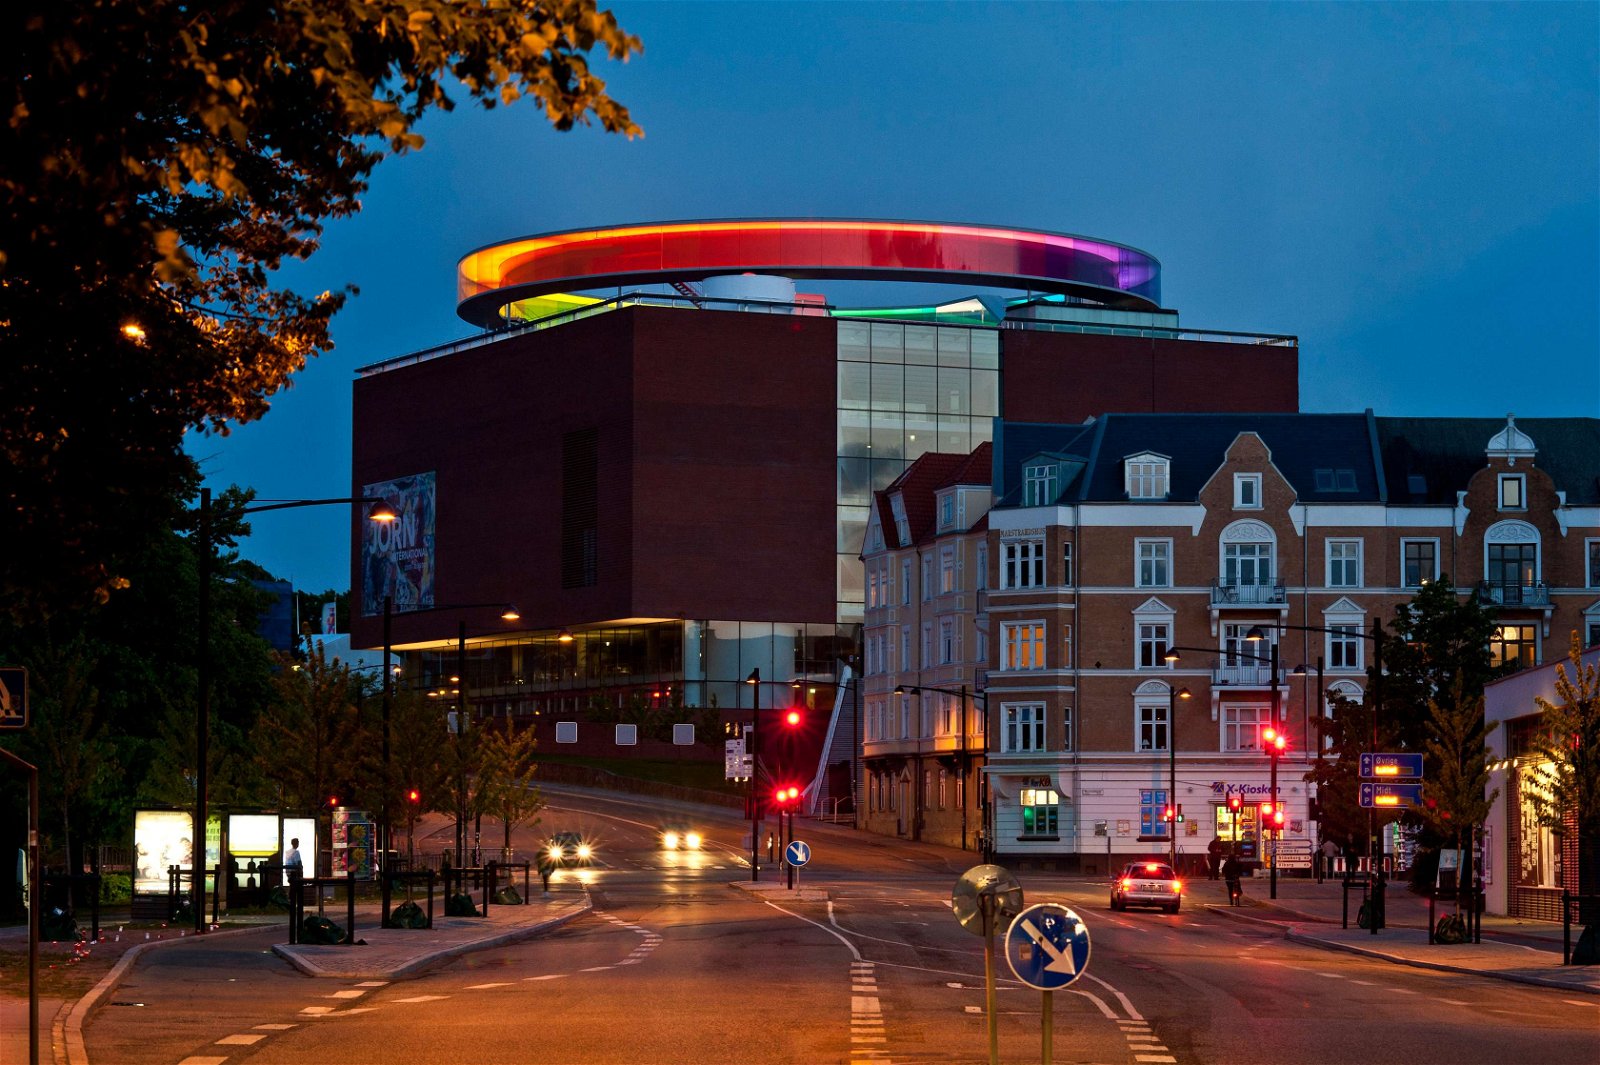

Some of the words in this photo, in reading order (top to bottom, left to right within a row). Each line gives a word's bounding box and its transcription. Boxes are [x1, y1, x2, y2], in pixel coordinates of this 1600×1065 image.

[369, 513, 416, 554] JORN
[1375, 756, 1398, 765] Øvrige
[1226, 783, 1281, 794] X-Kiosken
[1376, 786, 1392, 794] Midt
